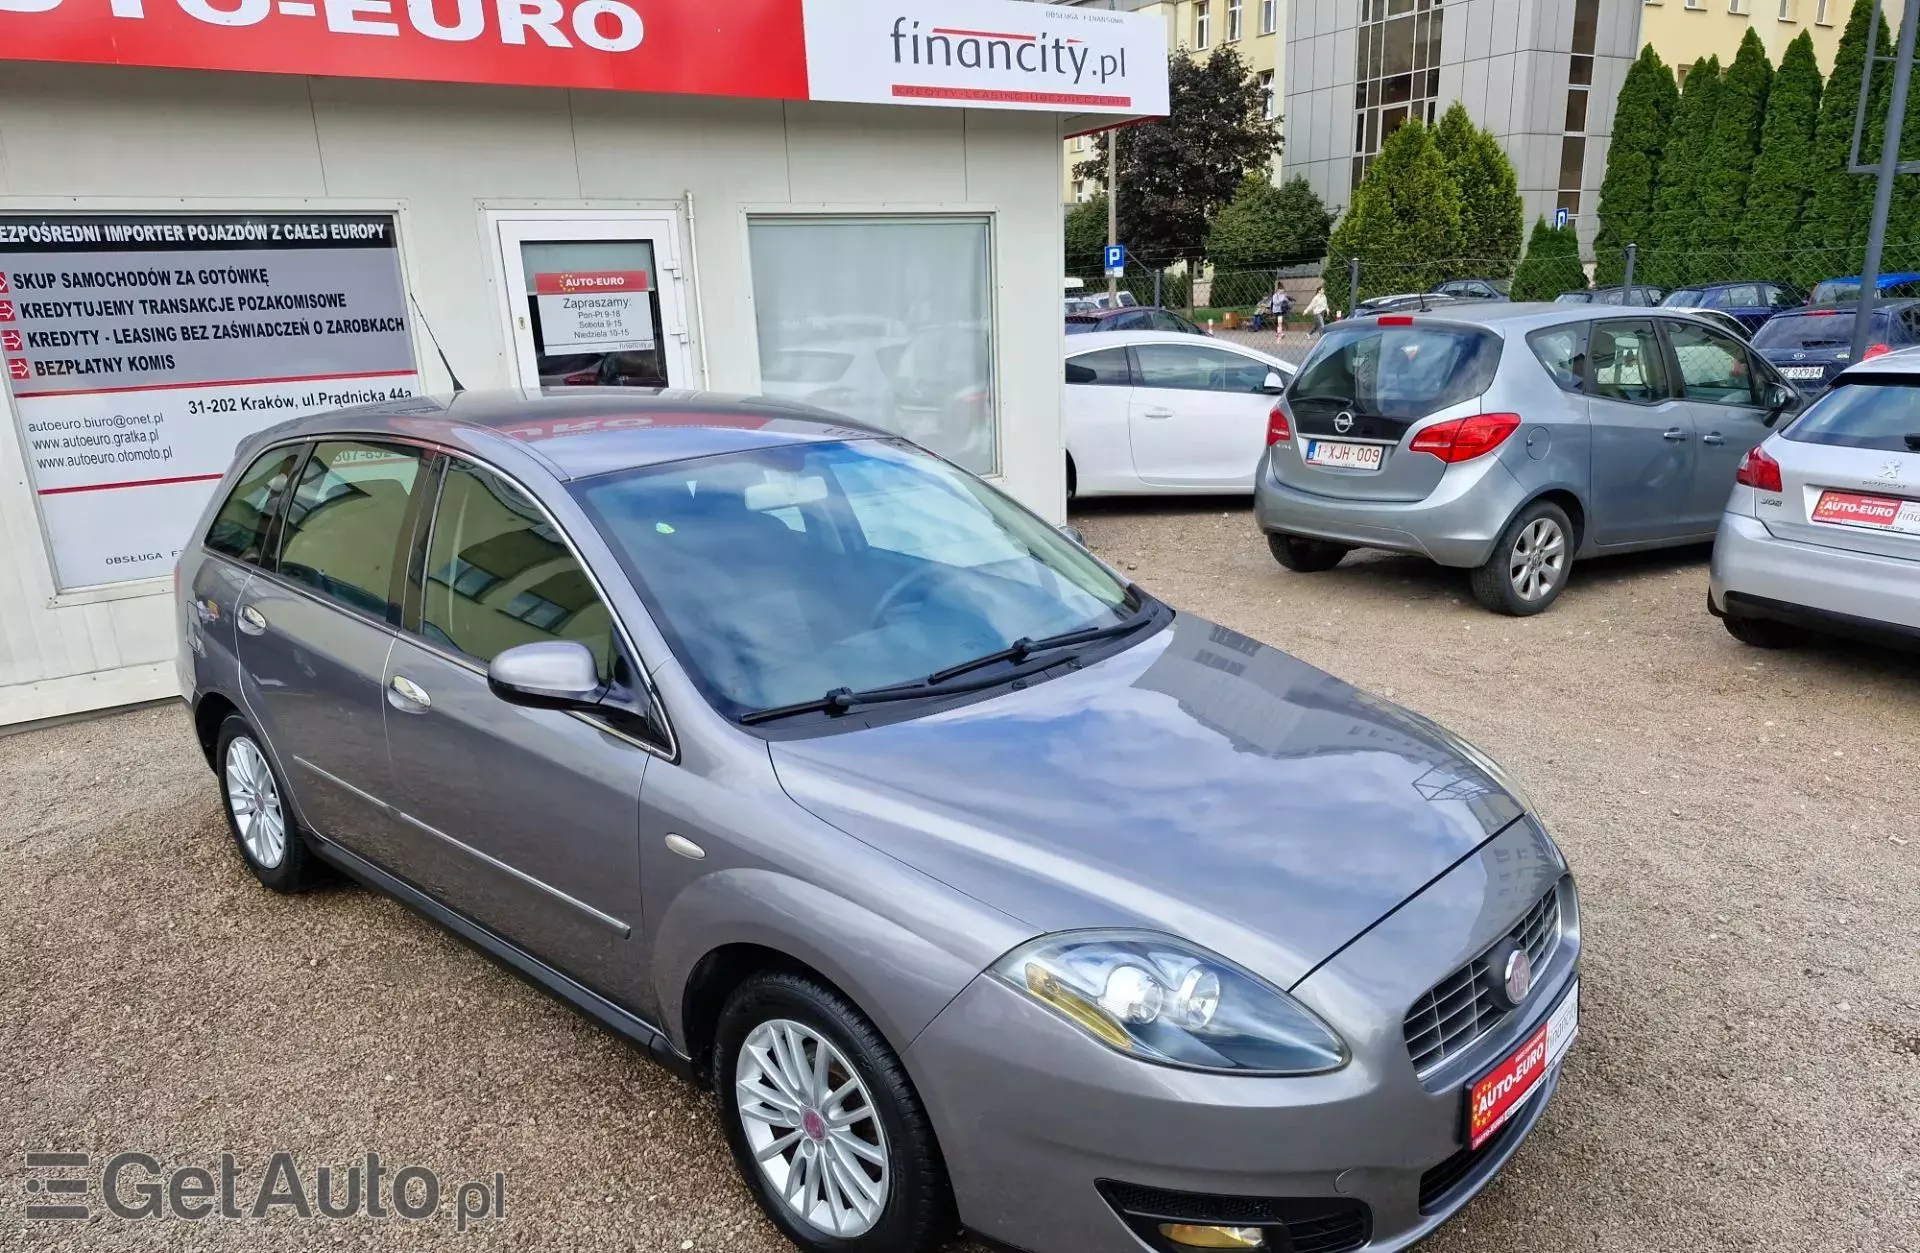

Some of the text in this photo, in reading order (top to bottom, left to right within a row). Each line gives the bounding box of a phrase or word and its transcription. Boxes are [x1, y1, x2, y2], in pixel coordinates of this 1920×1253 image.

[0, 0, 644, 52] -EURO
[890, 16, 1126, 84] financity.pl
[104, 225, 186, 242] IMPORTER
[188, 221, 267, 241] POJAZDÓW
[271, 224, 282, 240] Z
[283, 224, 328, 240] CAŁEJ
[331, 223, 385, 239] EUROPY
[1109, 248, 1120, 266] P
[13, 266, 270, 289] SKUP SAMOCHODÓW ZA GOTÓWKĘ
[565, 277, 625, 287] AUTO-EURO
[20, 293, 347, 319] KREDYTUJEMY TRANSAKCJE POZAKOMISOWE
[604, 310, 621, 318] 9-18
[27, 330, 99, 348] KREDYTY
[113, 327, 177, 344] LEASING
[181, 325, 207, 341] BEZ
[213, 317, 310, 340] ZAŚWIADCZEŃ
[313, 320, 323, 335] O
[326, 317, 405, 335] ZAROBKACH
[574, 329, 630, 339] Niedziela 10-15
[579, 319, 622, 329] Sobota 9-15
[34, 354, 176, 377] BEZPŁATNY KOMIS
[188, 387, 412, 415] 31-202 Kraków, ul.Prądnicka 44a
[28, 412, 164, 432] autoeuro.biuro@onet.pl
[32, 428, 160, 450] www.autoeuro.gratka.pl
[36, 446, 173, 469] www.autoeuro.otomoto.pl
[1824, 500, 1895, 518] AUTO-EURO
[105, 552, 163, 565] OBSŁUGA
[1478, 1042, 1544, 1115] AUTO-EURO
